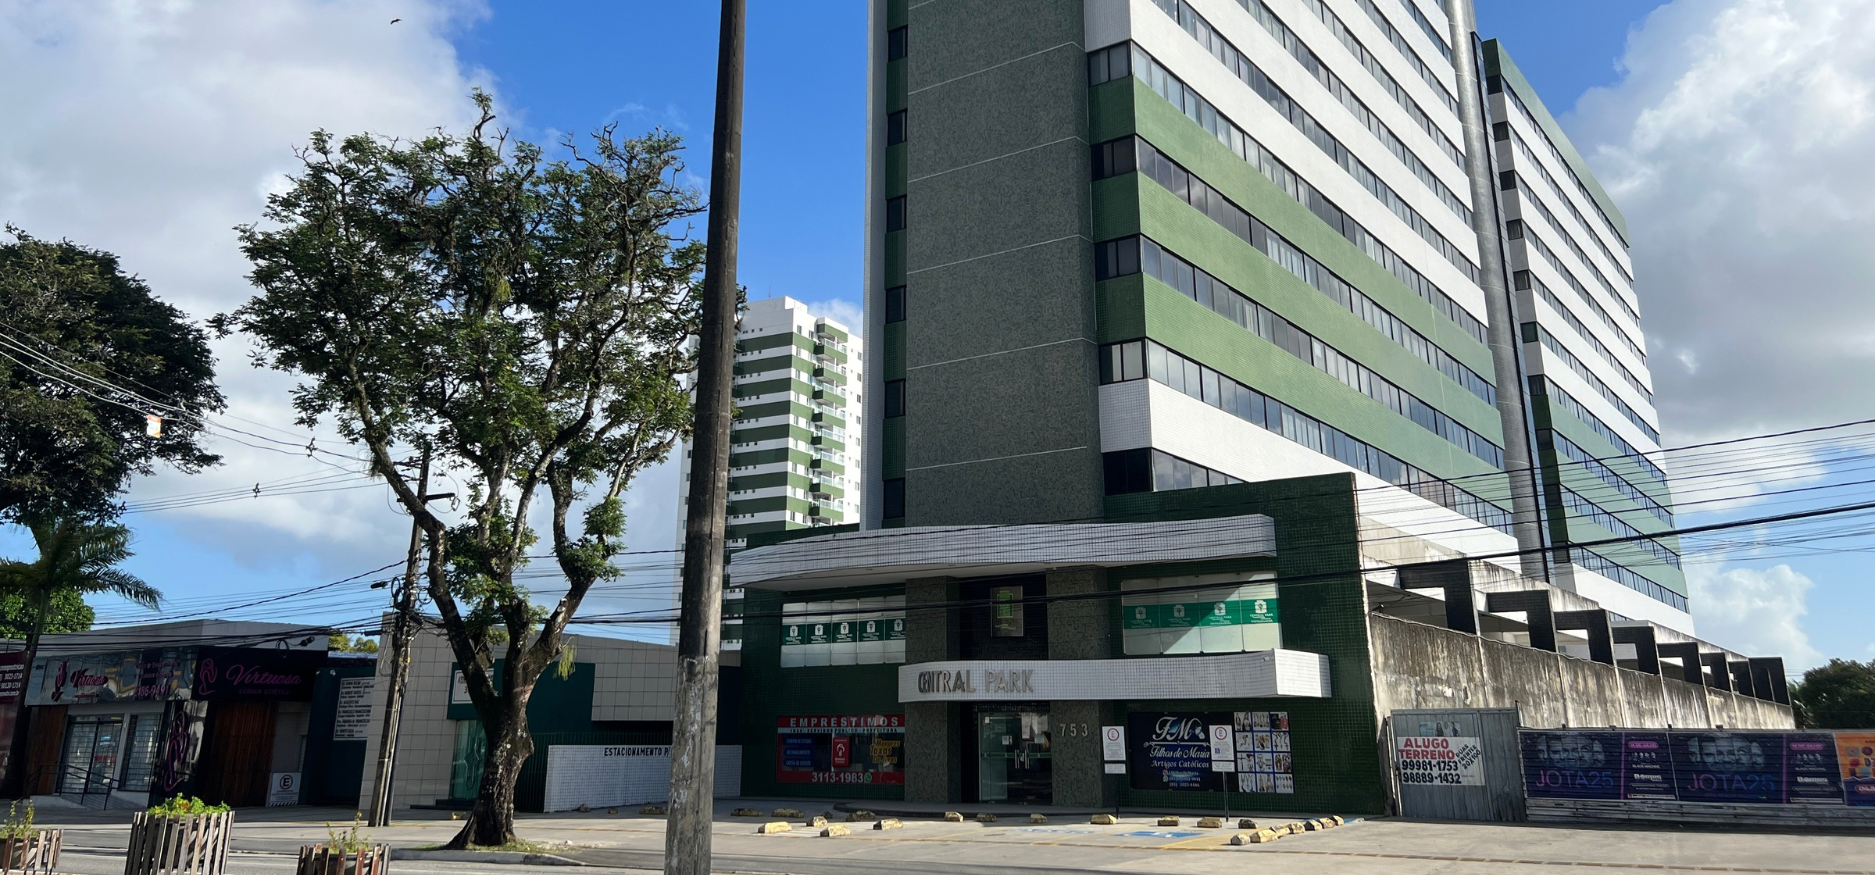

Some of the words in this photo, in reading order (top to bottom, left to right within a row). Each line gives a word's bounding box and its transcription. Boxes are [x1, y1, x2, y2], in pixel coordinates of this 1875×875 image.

[226, 664, 302, 686] Virtuosa
[918, 670, 976, 693] CENTRAL
[985, 669, 1034, 693] PARK
[1060, 723, 1088, 737] 753
[1404, 738, 1449, 749] ALUGO
[604, 747, 663, 757] ESTACIONAMENTO
[1173, 747, 1183, 758] de
[1183, 746, 1210, 758] Maria
[1398, 749, 1455, 760] TERRENO
[1455, 744, 1469, 758] DUAS
[1151, 760, 1177, 769] Artigos
[1178, 760, 1209, 768] Católicos
[1402, 760, 1458, 771] 99981-1753
[283, 777, 291, 787] E
[812, 772, 864, 783] 3113-1983
[1402, 772, 1462, 784] 98889-1432
[1535, 769, 1615, 789] JOTA25
[1687, 772, 1776, 792] JOTA25
